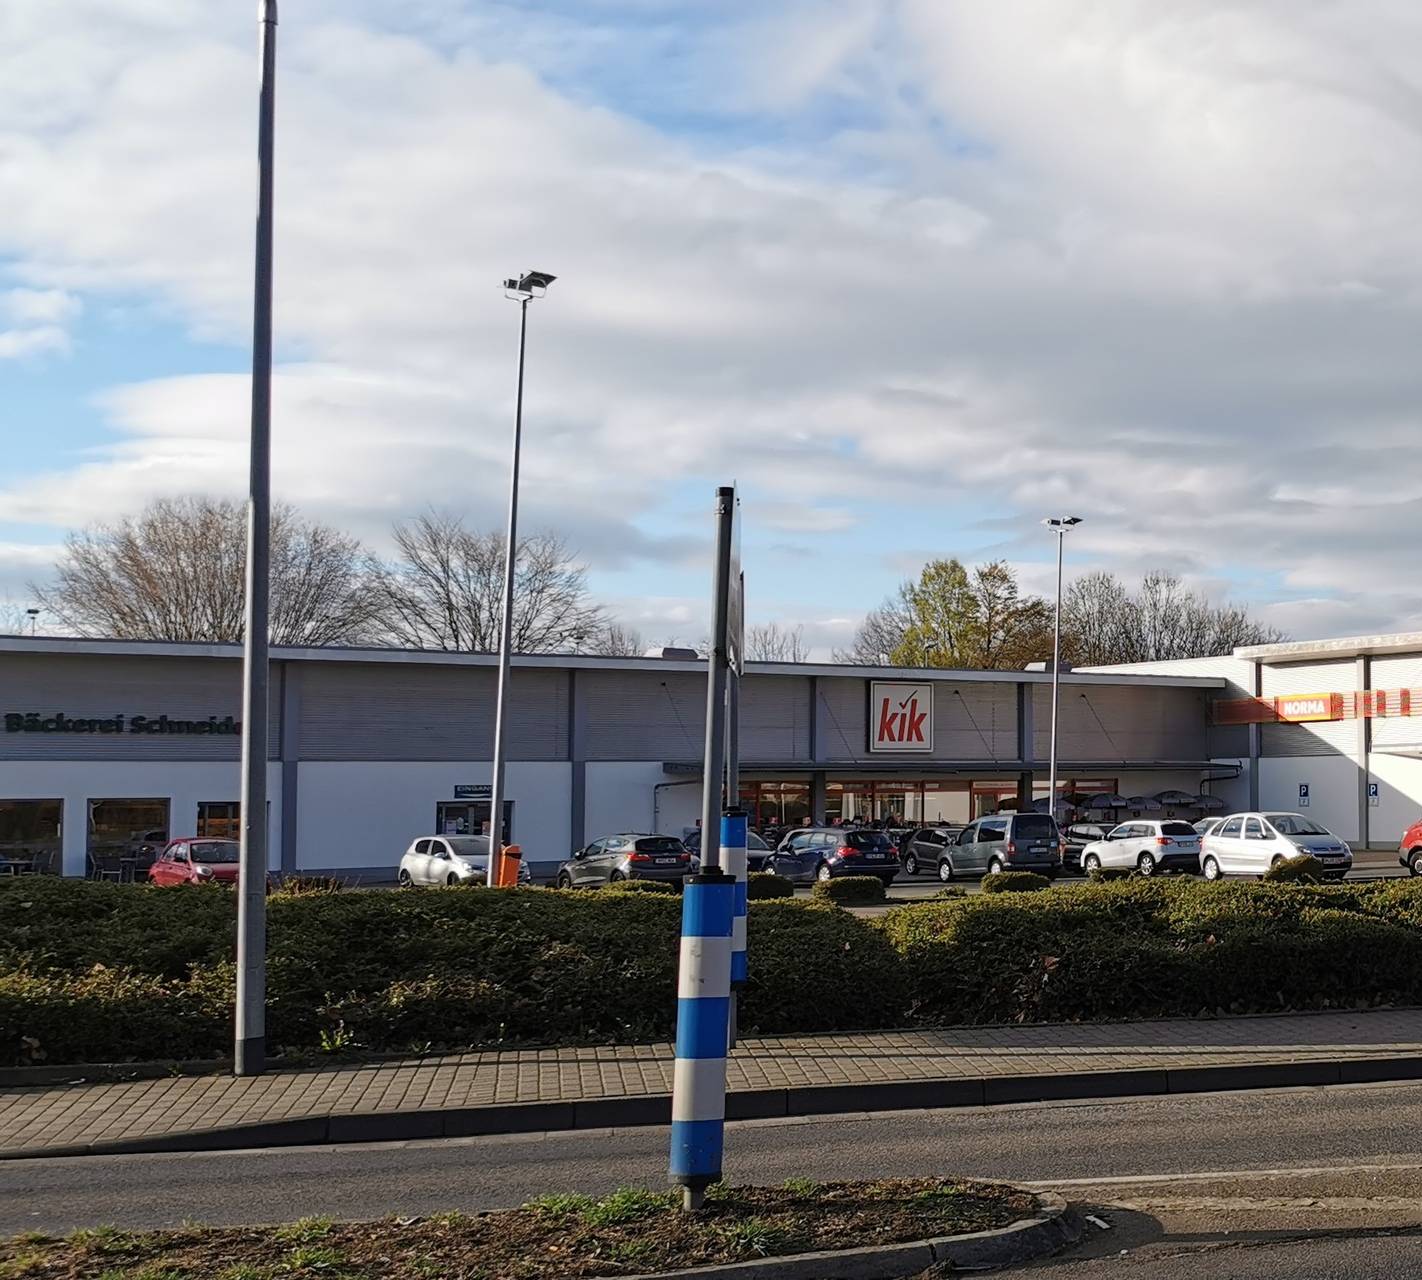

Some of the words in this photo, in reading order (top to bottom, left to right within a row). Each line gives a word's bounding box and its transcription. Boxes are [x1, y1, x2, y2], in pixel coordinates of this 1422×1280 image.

[1284, 701, 1325, 714] NORMA
[4, 713, 124, 732] Bäckerei
[878, 698, 927, 742] kik
